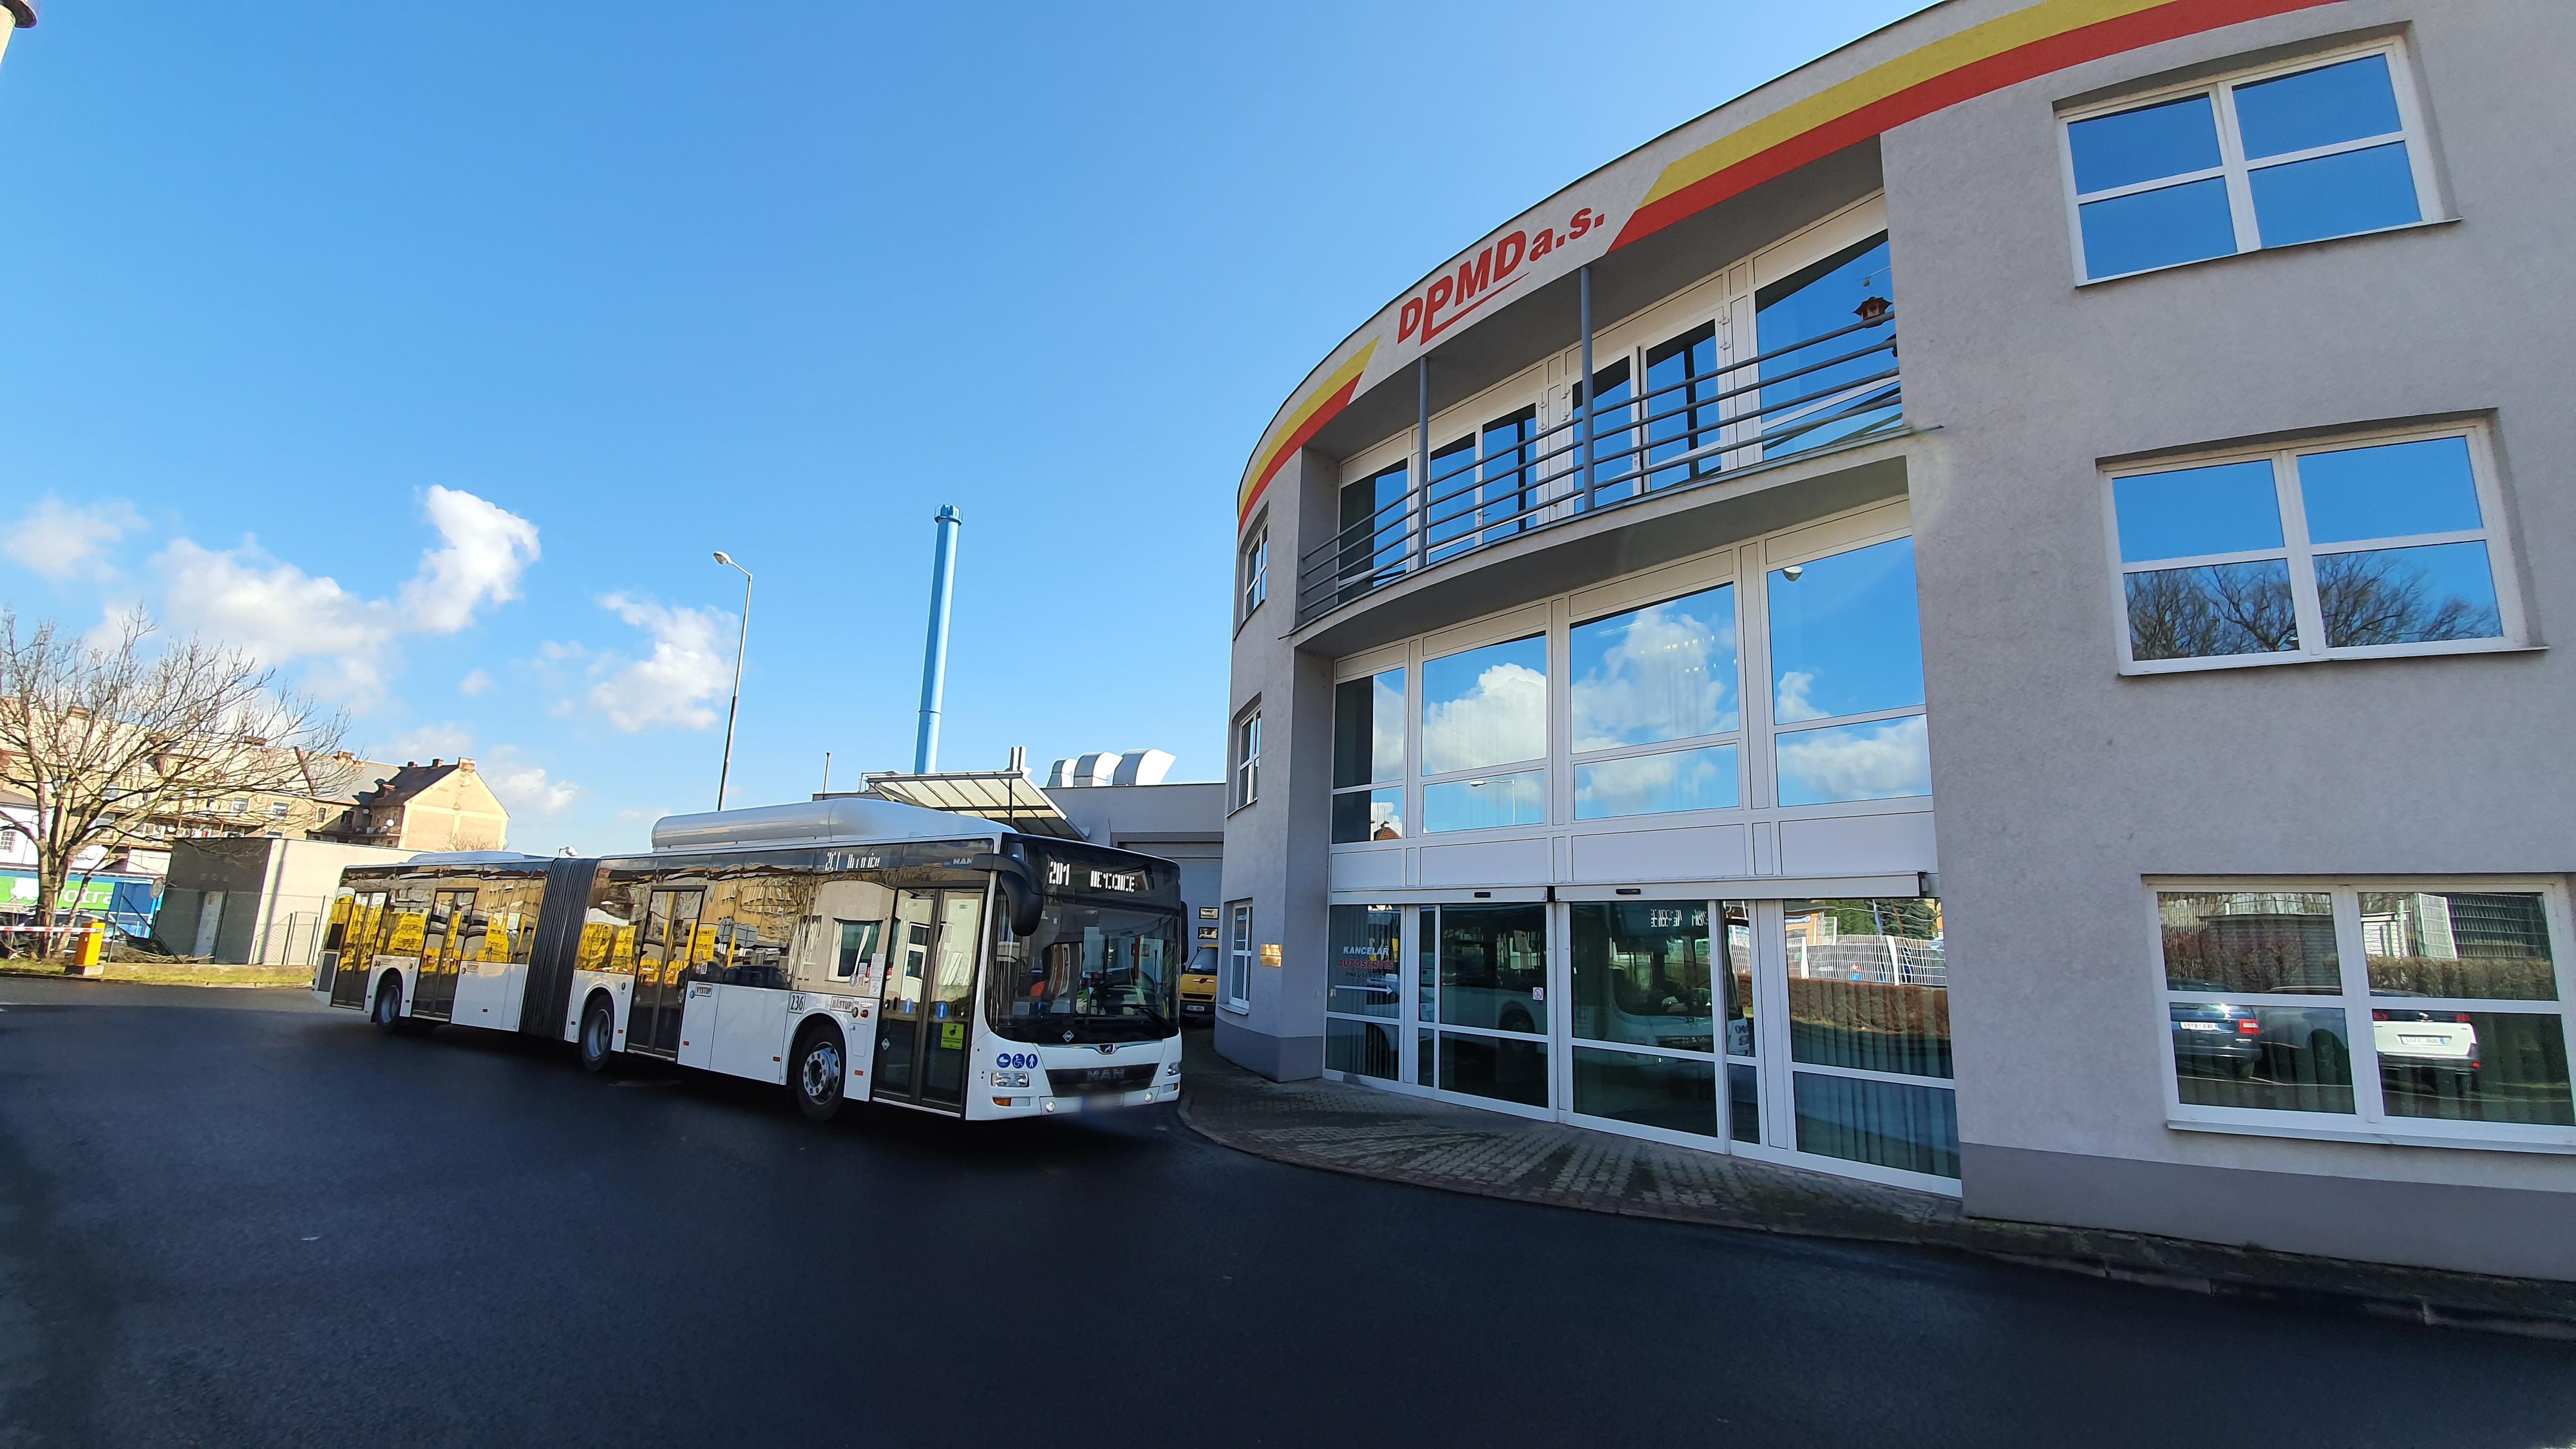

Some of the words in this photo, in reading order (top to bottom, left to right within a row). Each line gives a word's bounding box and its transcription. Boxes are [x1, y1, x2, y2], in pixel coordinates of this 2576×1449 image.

[1397, 230, 1530, 346] DPMD
[1529, 207, 1605, 262] a.s.
[1048, 861, 1070, 886] 201
[1337, 960, 1394, 970] AUTOSERVIS
[791, 995, 804, 1011] 236
[1086, 1068, 1125, 1081] MAN
